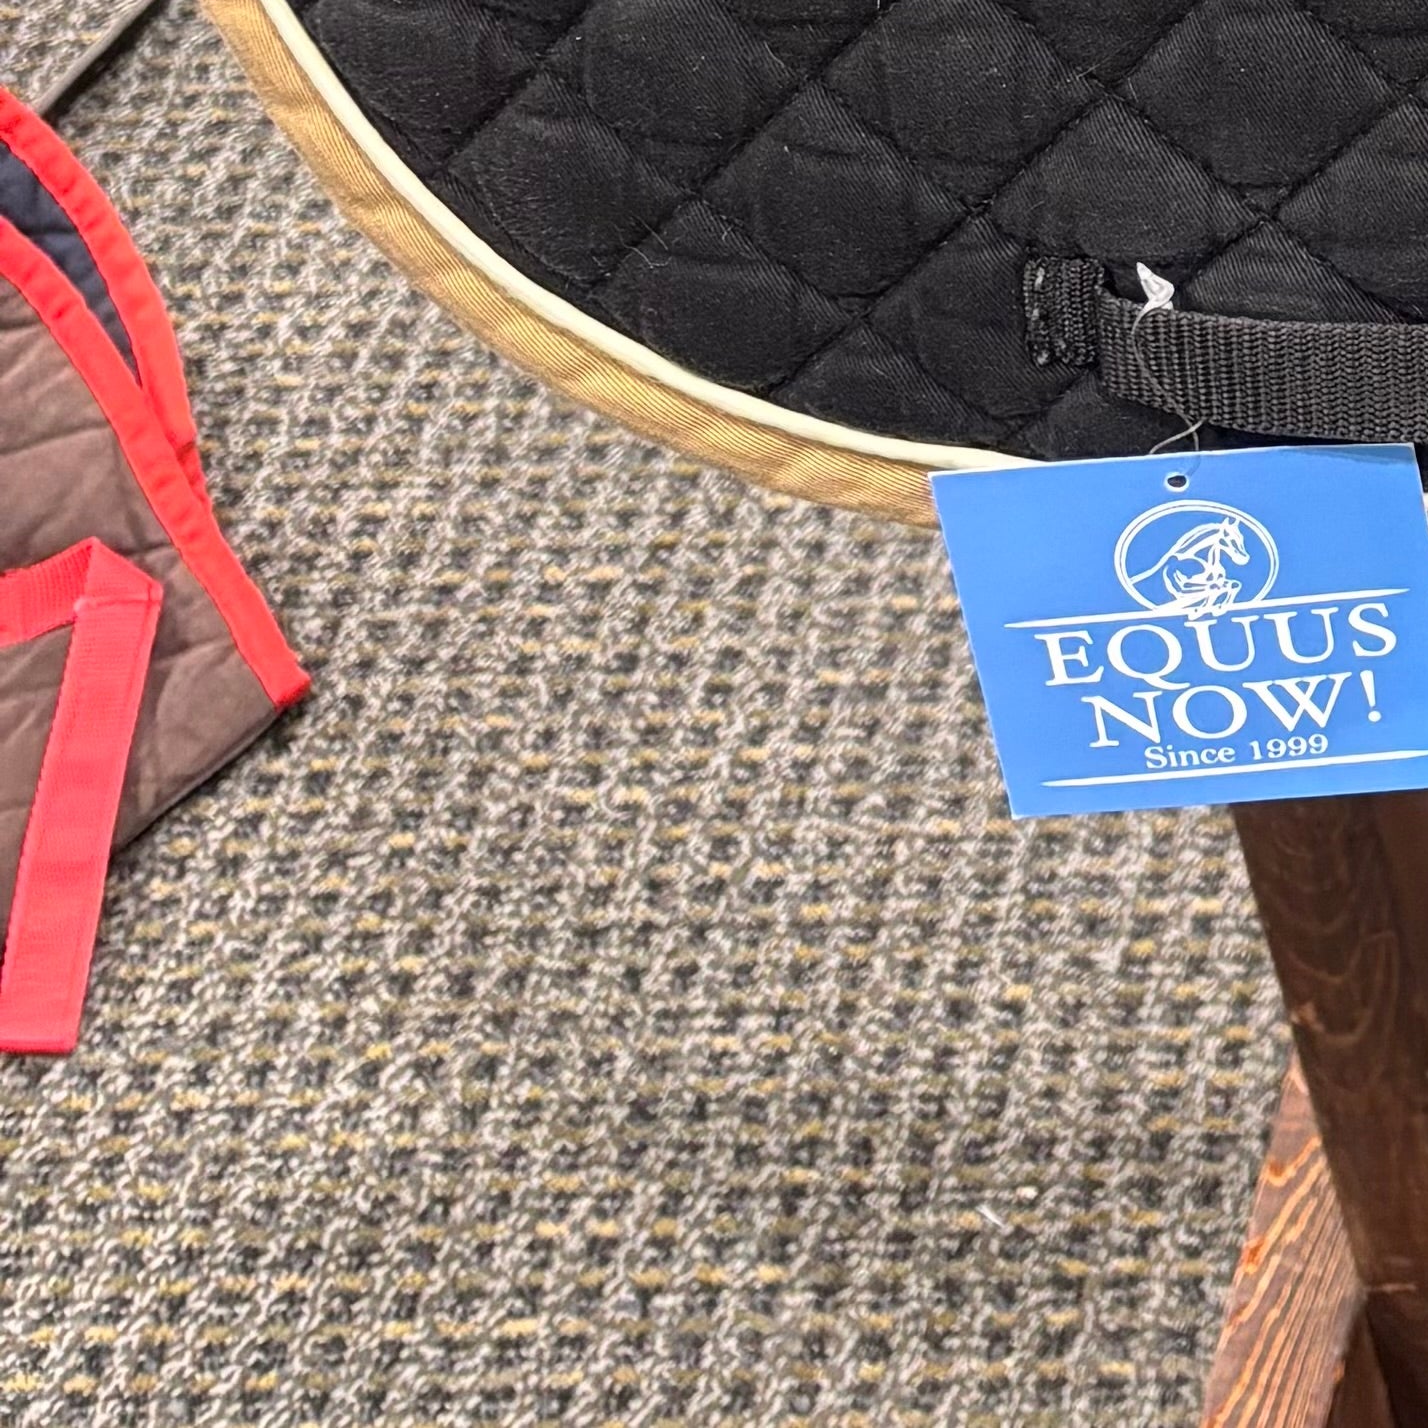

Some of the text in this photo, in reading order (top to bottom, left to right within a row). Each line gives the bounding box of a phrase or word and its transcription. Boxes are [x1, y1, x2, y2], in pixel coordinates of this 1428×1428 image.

[1034, 602, 1397, 690] EQUUS
[1081, 670, 1382, 749] NOW!
[1144, 733, 1329, 770] Since 1999
